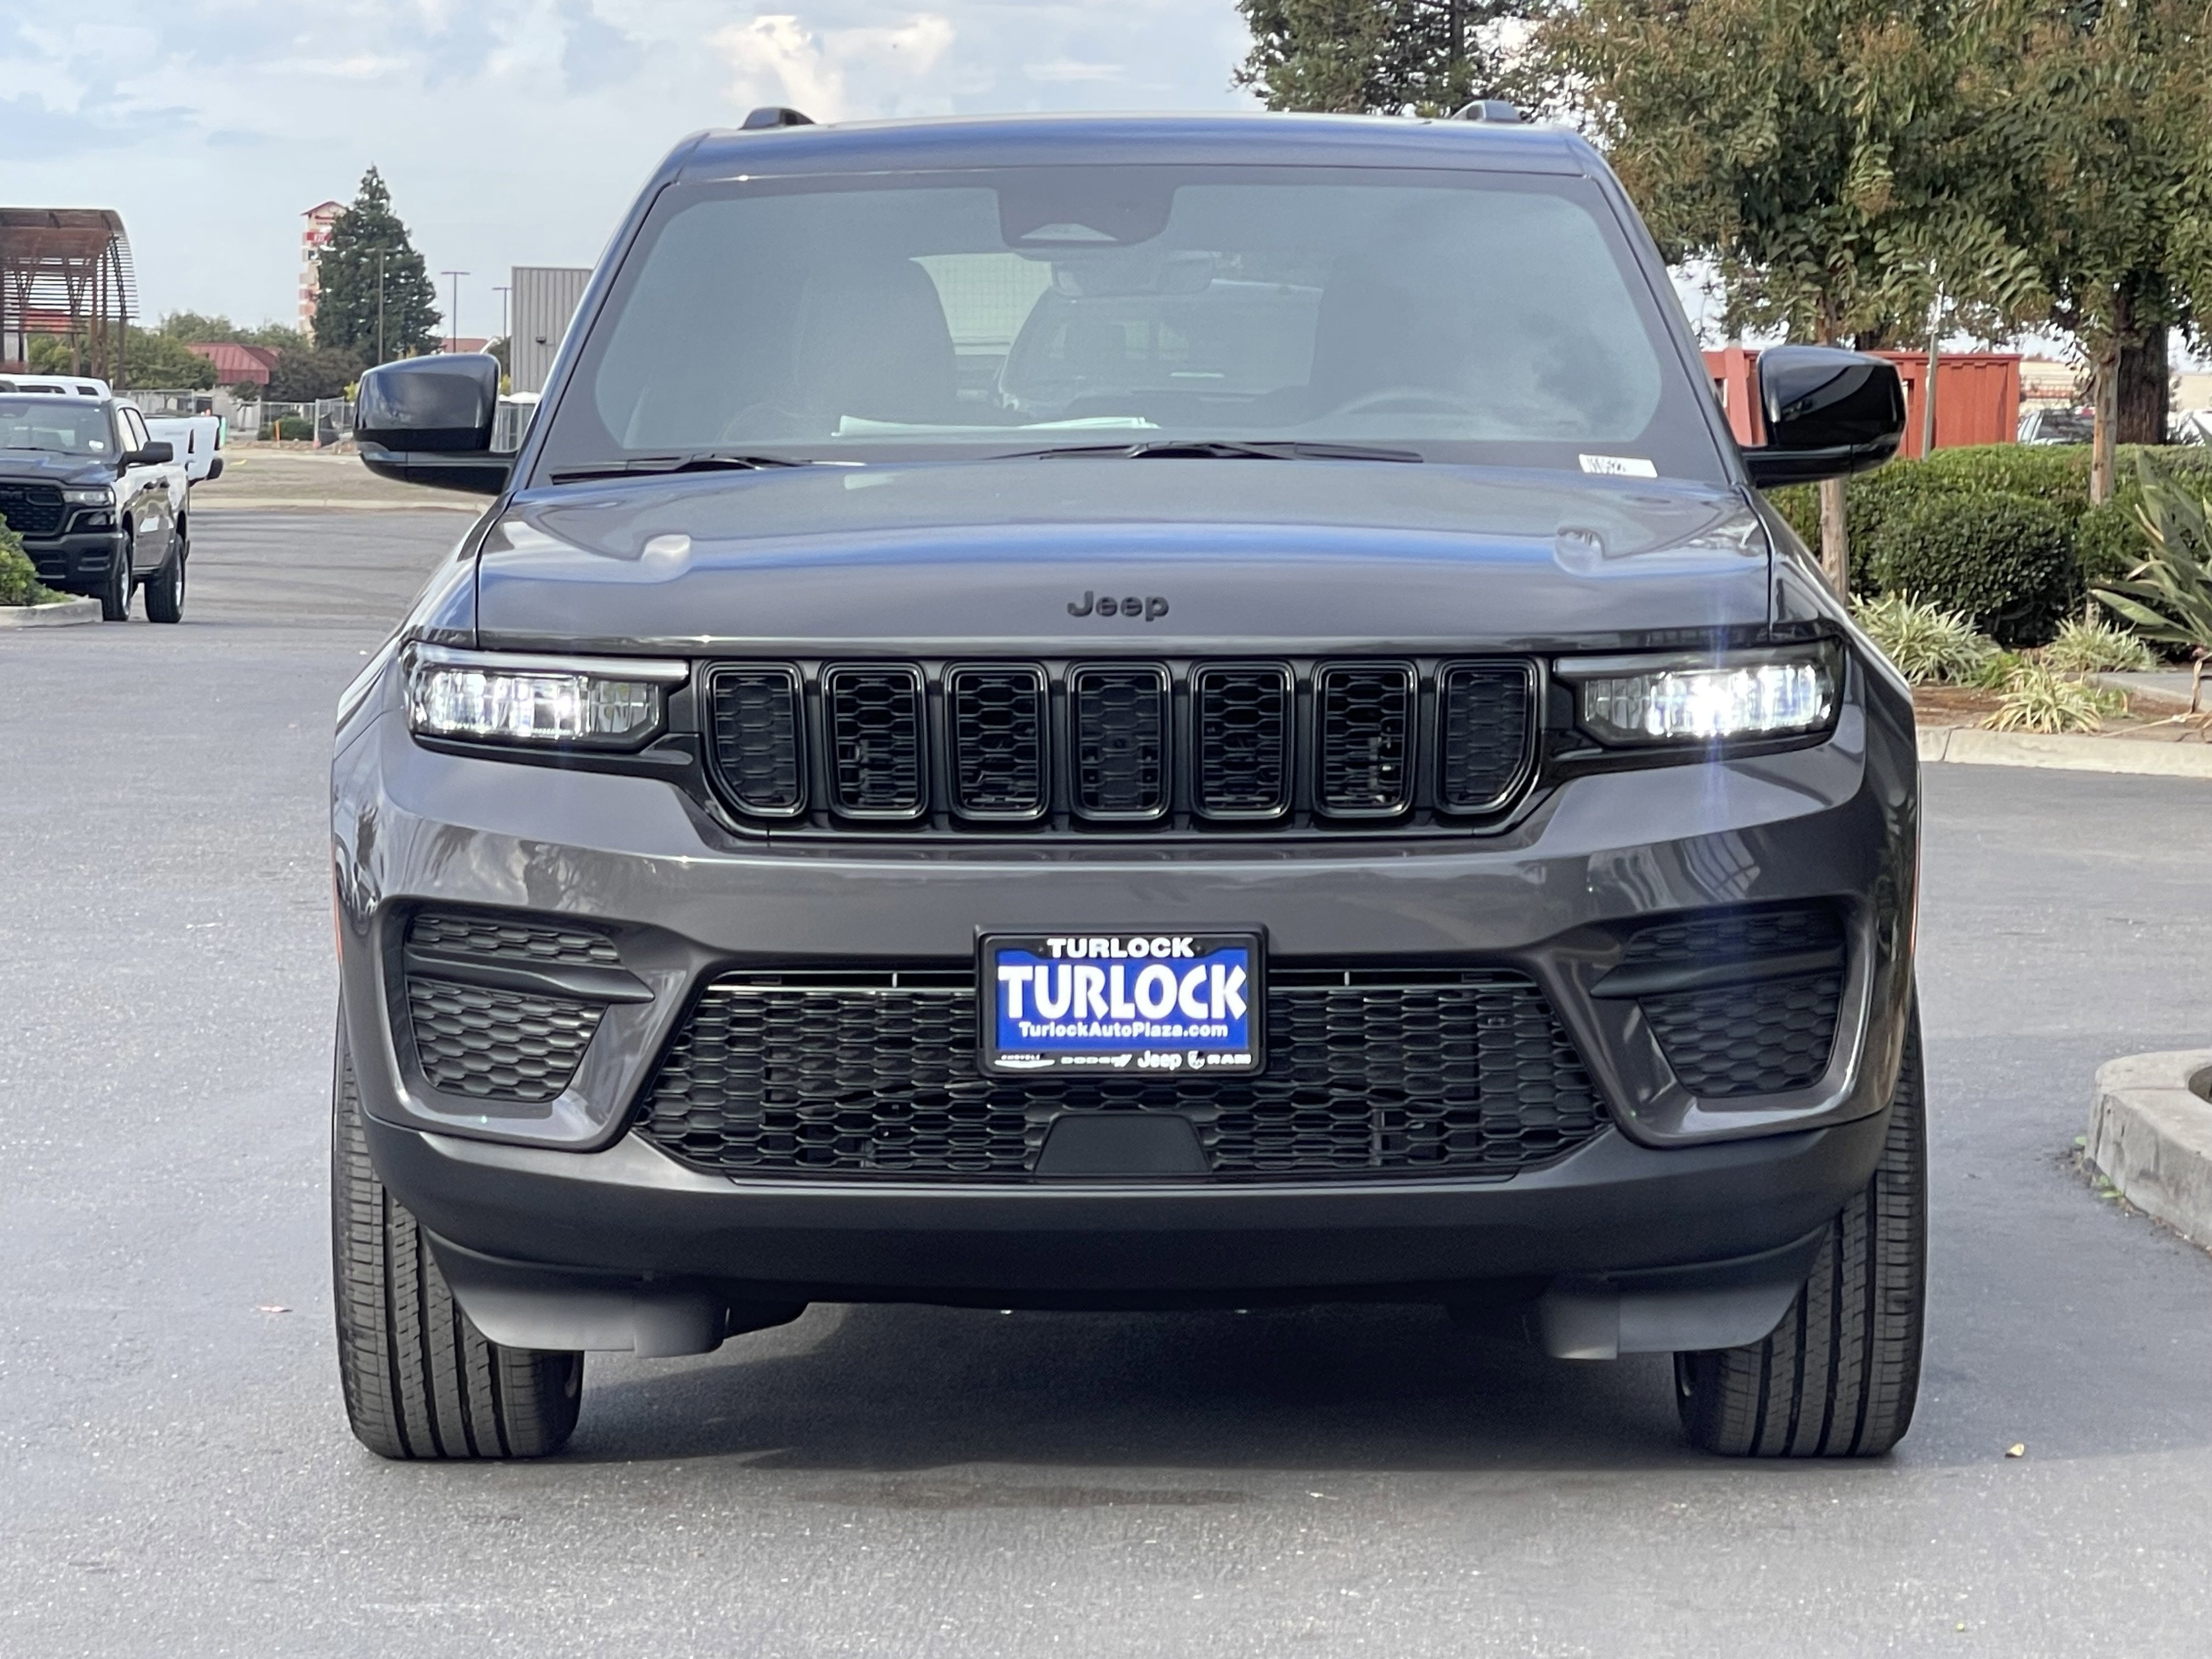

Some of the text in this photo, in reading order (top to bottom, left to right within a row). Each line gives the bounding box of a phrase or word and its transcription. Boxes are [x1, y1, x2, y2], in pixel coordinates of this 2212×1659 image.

[1067, 590, 1169, 622] Jeep
[1047, 937, 1194, 958] TURLOCK
[997, 963, 1248, 1020] TURLOCK
[1019, 1021, 1228, 1038] TurlockAutoPlaza.com
[1137, 1049, 1182, 1071] Jeep
